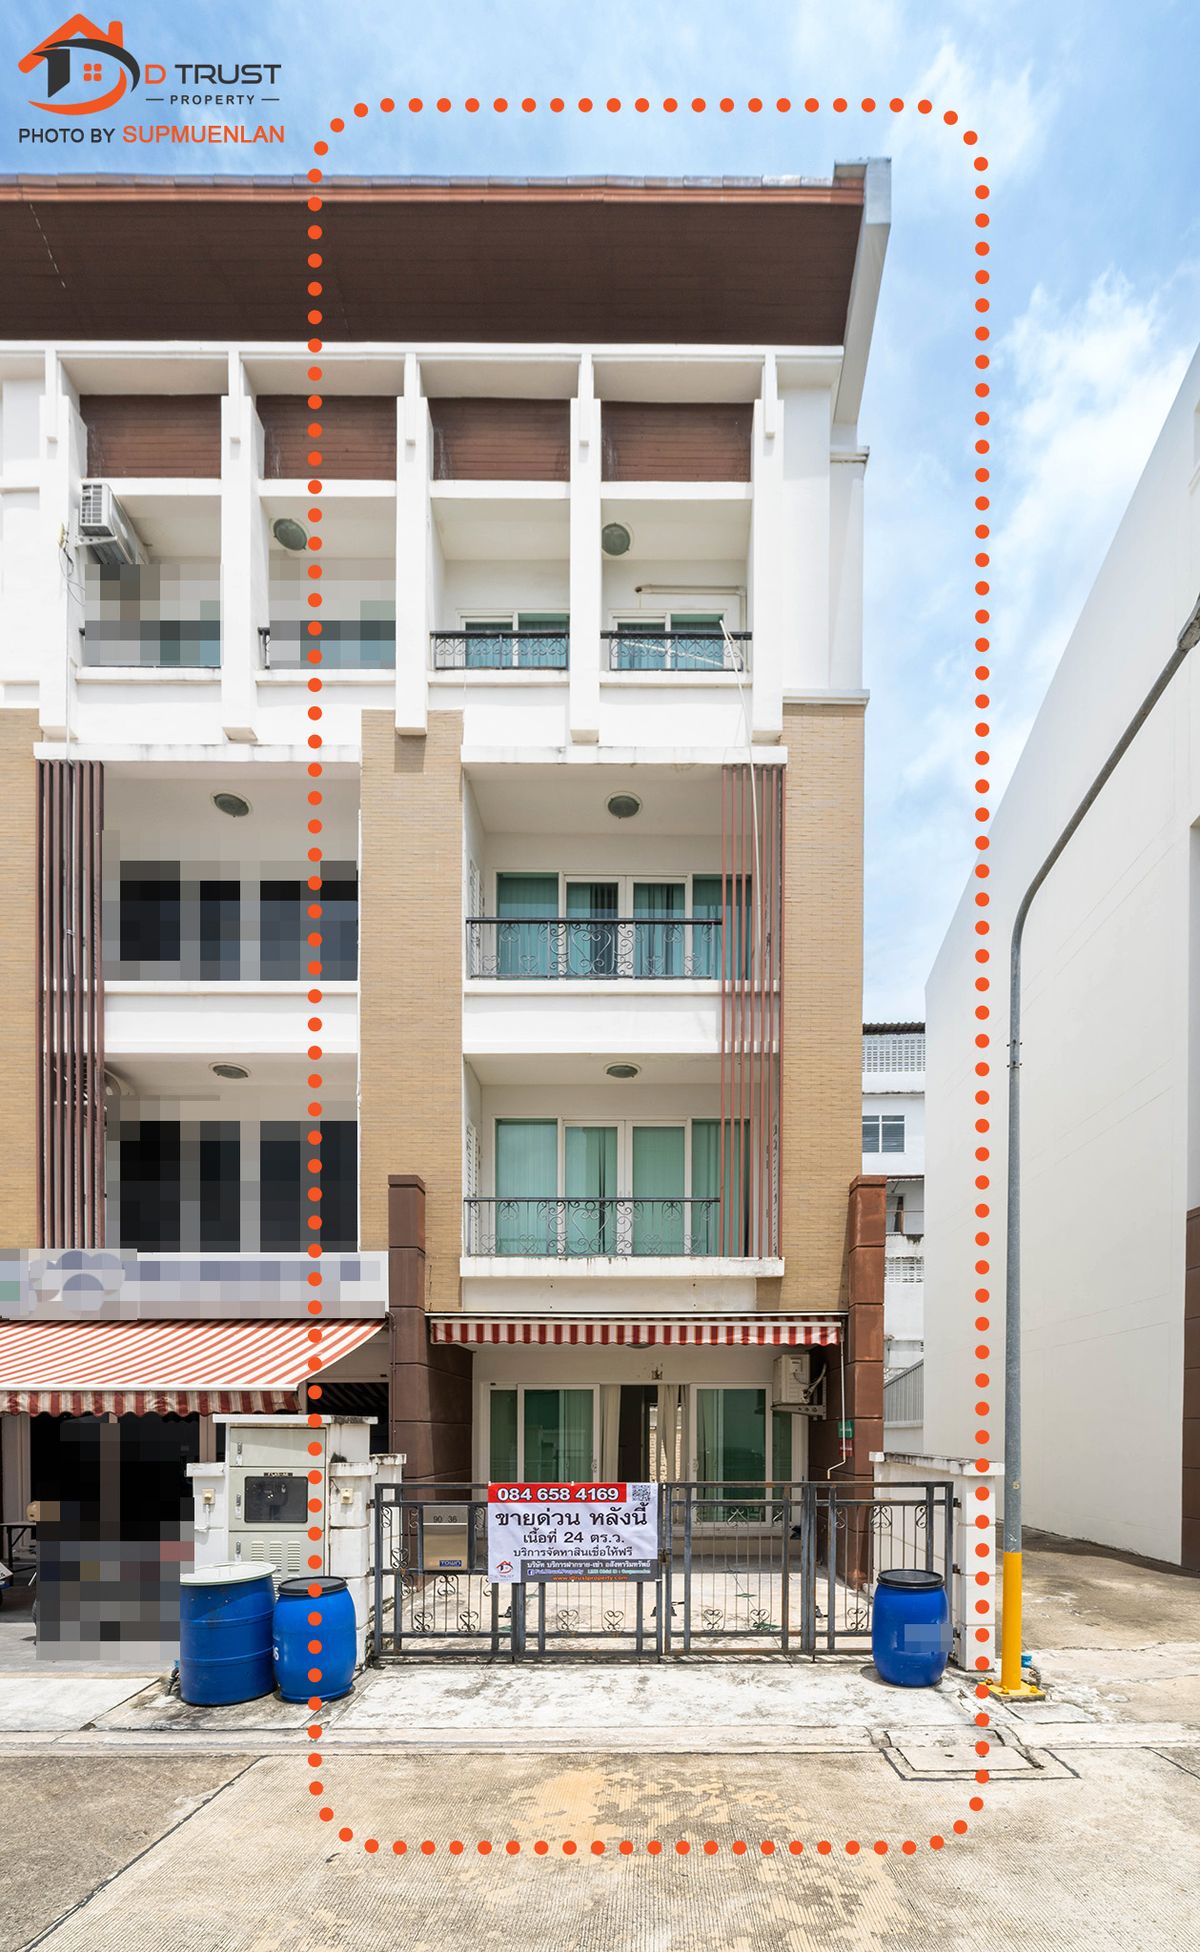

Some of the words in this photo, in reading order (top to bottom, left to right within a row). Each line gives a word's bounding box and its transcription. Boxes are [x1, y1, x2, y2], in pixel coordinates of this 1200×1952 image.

[497, 1487, 532, 1501] 084
[536, 1487, 570, 1501] 658
[575, 1487, 619, 1501] 4169
[495, 1508, 580, 1526] ขายด่วน
[589, 1502, 650, 1526] หลังนี้
[523, 1527, 557, 1544] เนื้อที่
[563, 1531, 584, 1543] 24
[590, 1533, 625, 1544] ตร.ว.
[513, 1546, 633, 1557] บริการจัดหาสินเชื่อให้ฟรี
